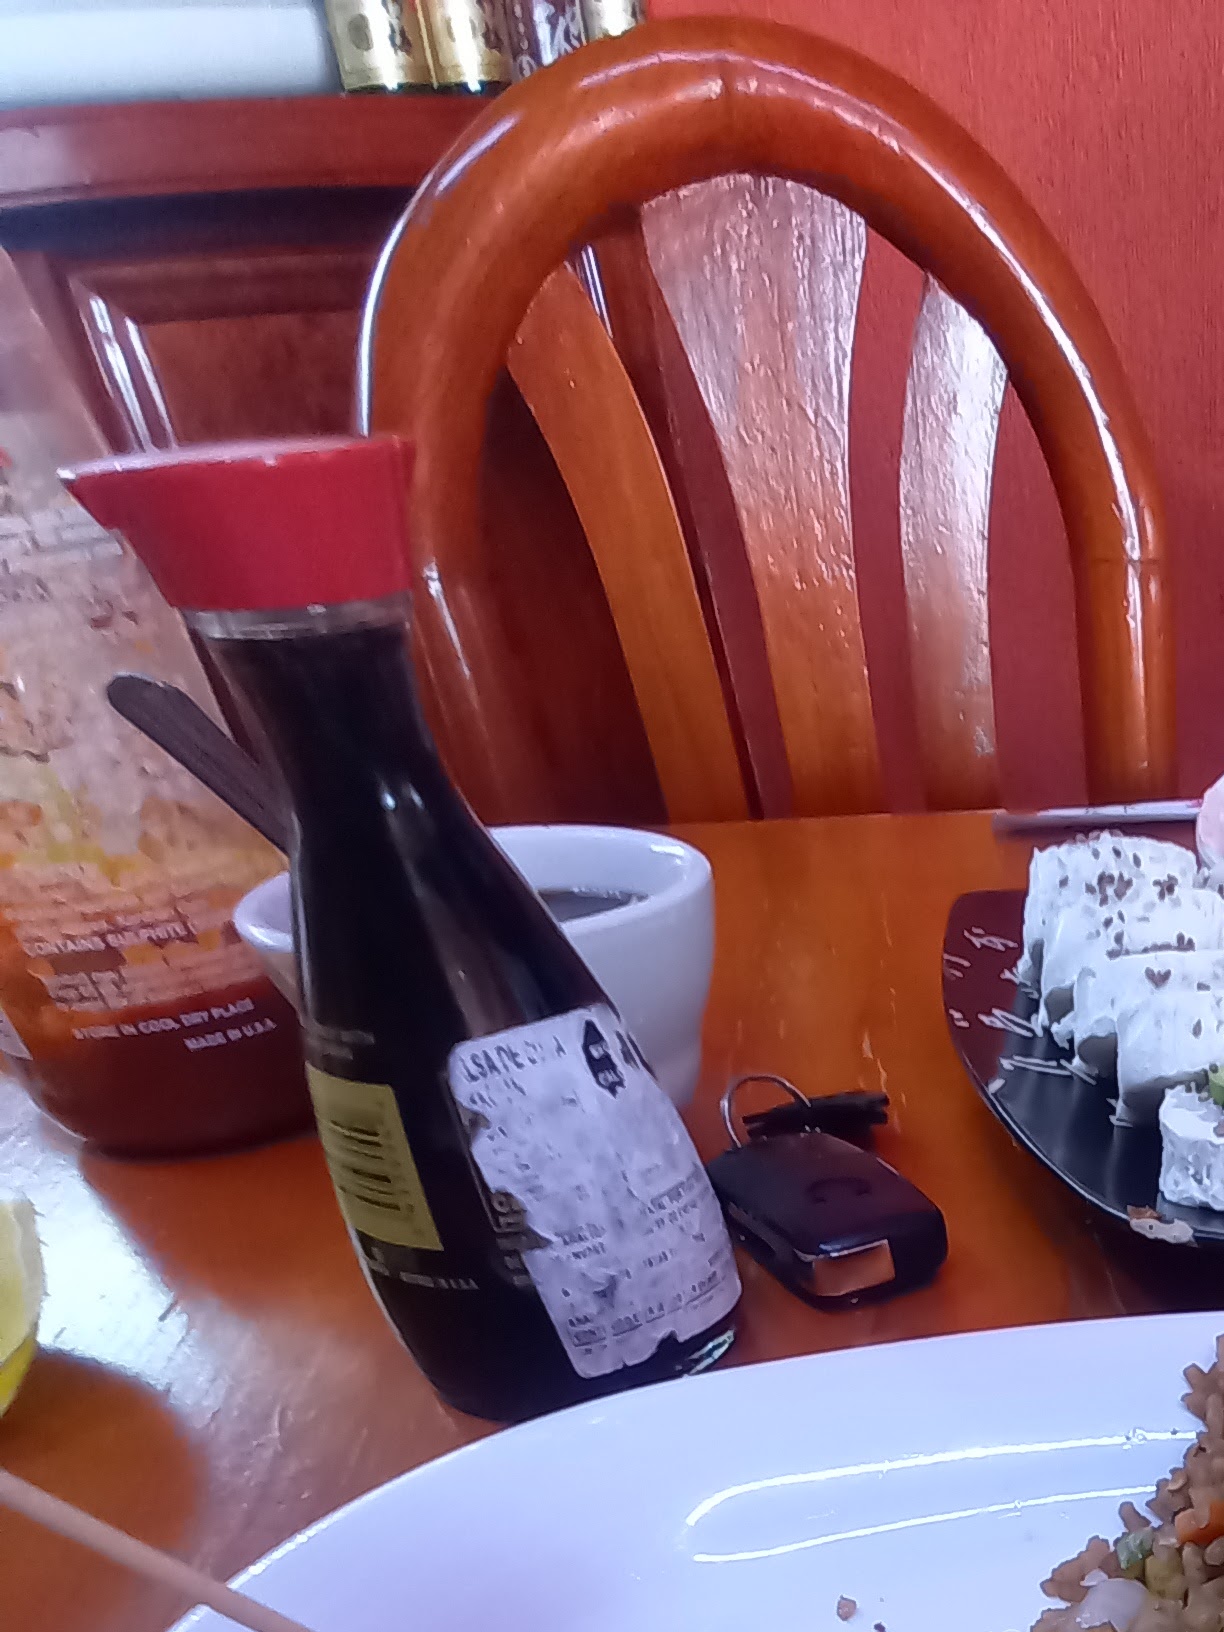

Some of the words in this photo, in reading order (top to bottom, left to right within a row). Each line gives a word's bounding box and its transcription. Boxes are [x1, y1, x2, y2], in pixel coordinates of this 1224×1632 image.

[210, 997, 254, 1020] PLACE
[183, 1032, 227, 1052] MADE
[226, 1028, 243, 1042] IN
